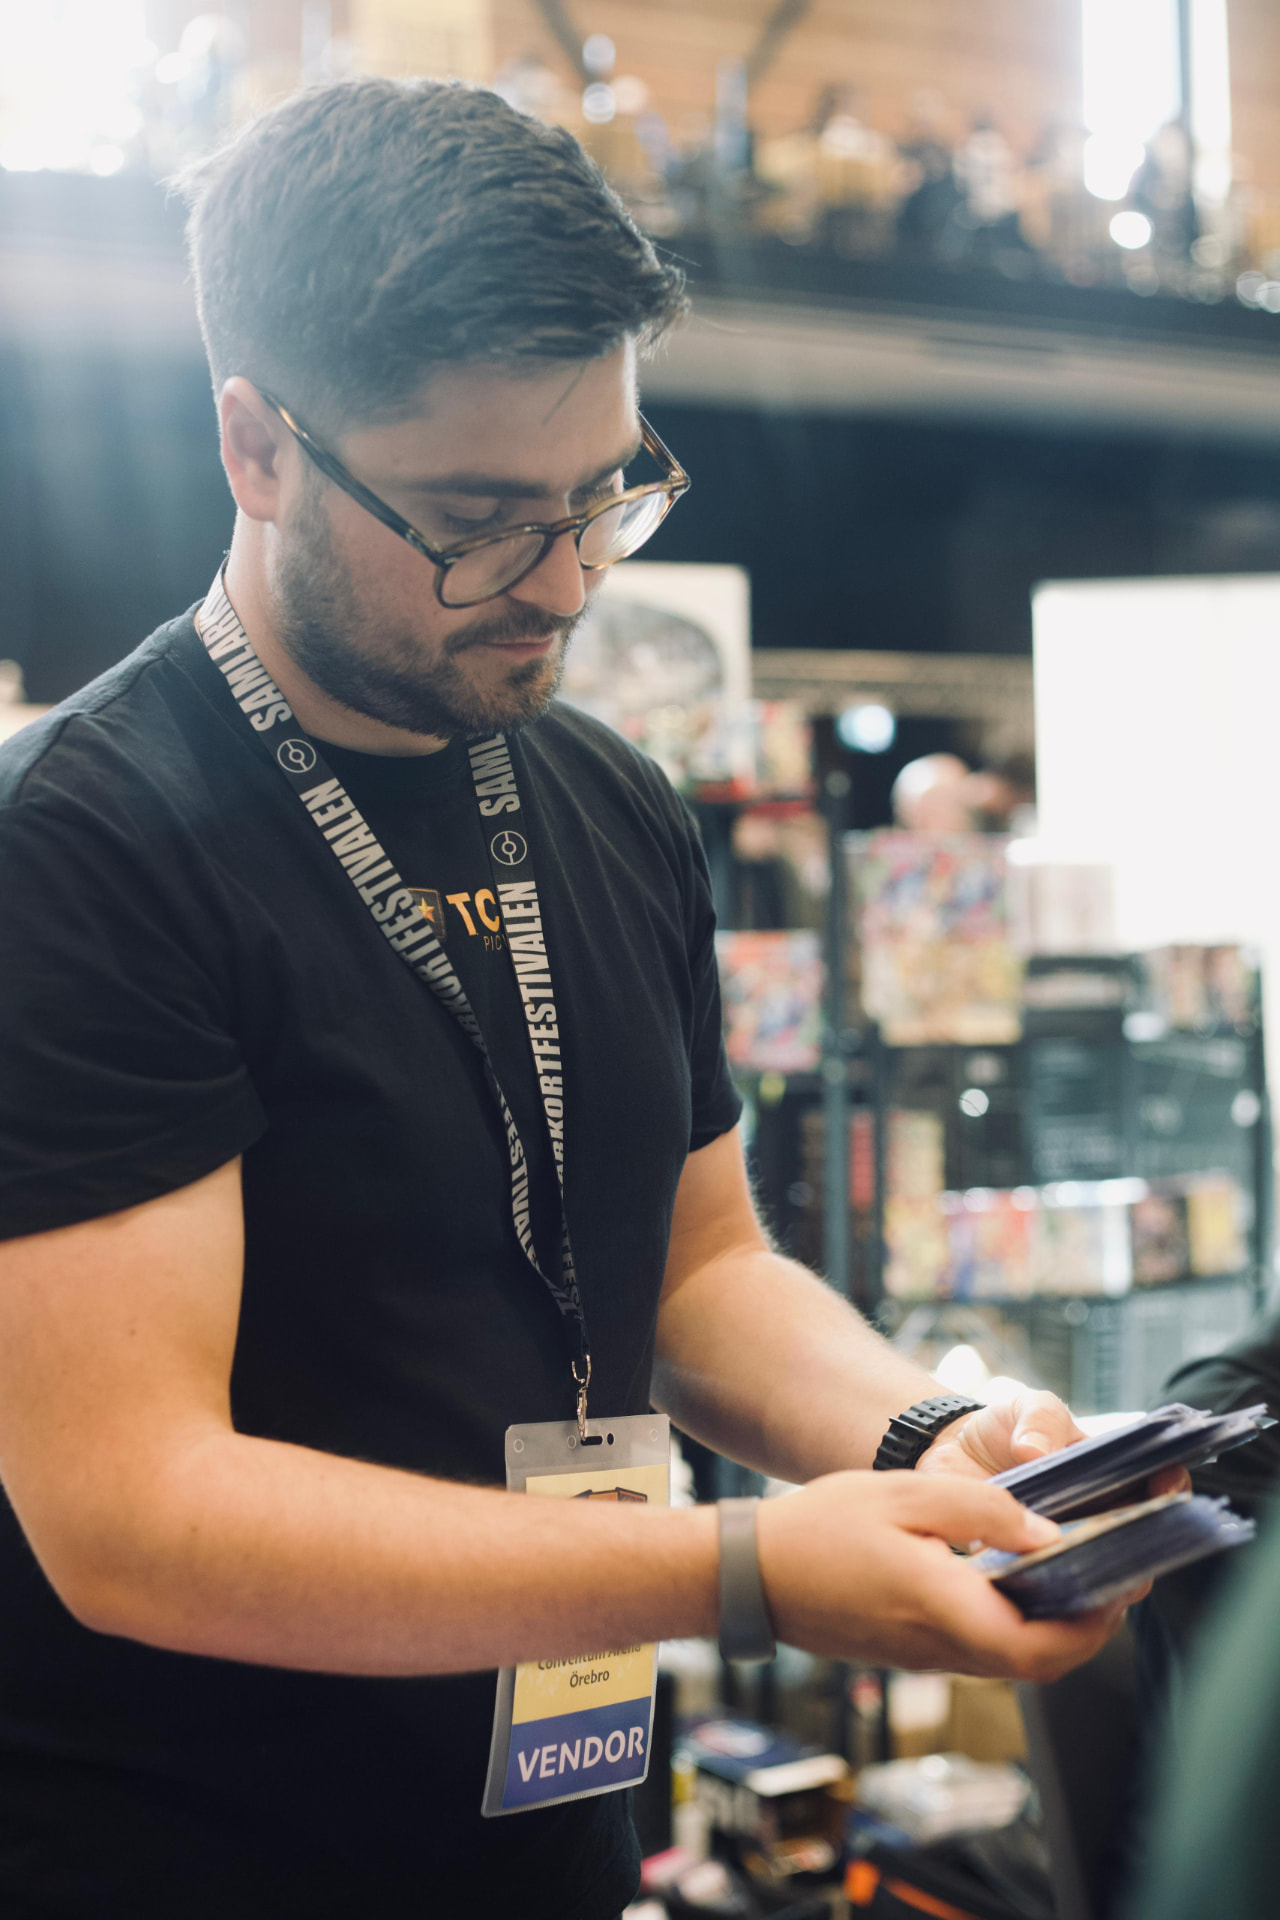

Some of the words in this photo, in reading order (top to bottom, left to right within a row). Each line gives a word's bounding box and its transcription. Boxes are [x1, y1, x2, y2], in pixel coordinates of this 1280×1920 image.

[468, 733, 521, 817] SAML
[445, 888, 500, 936] TC
[483, 933, 508, 952] PIC
[569, 1669, 610, 1688] Örebro
[517, 1725, 645, 1783] VENDOR
